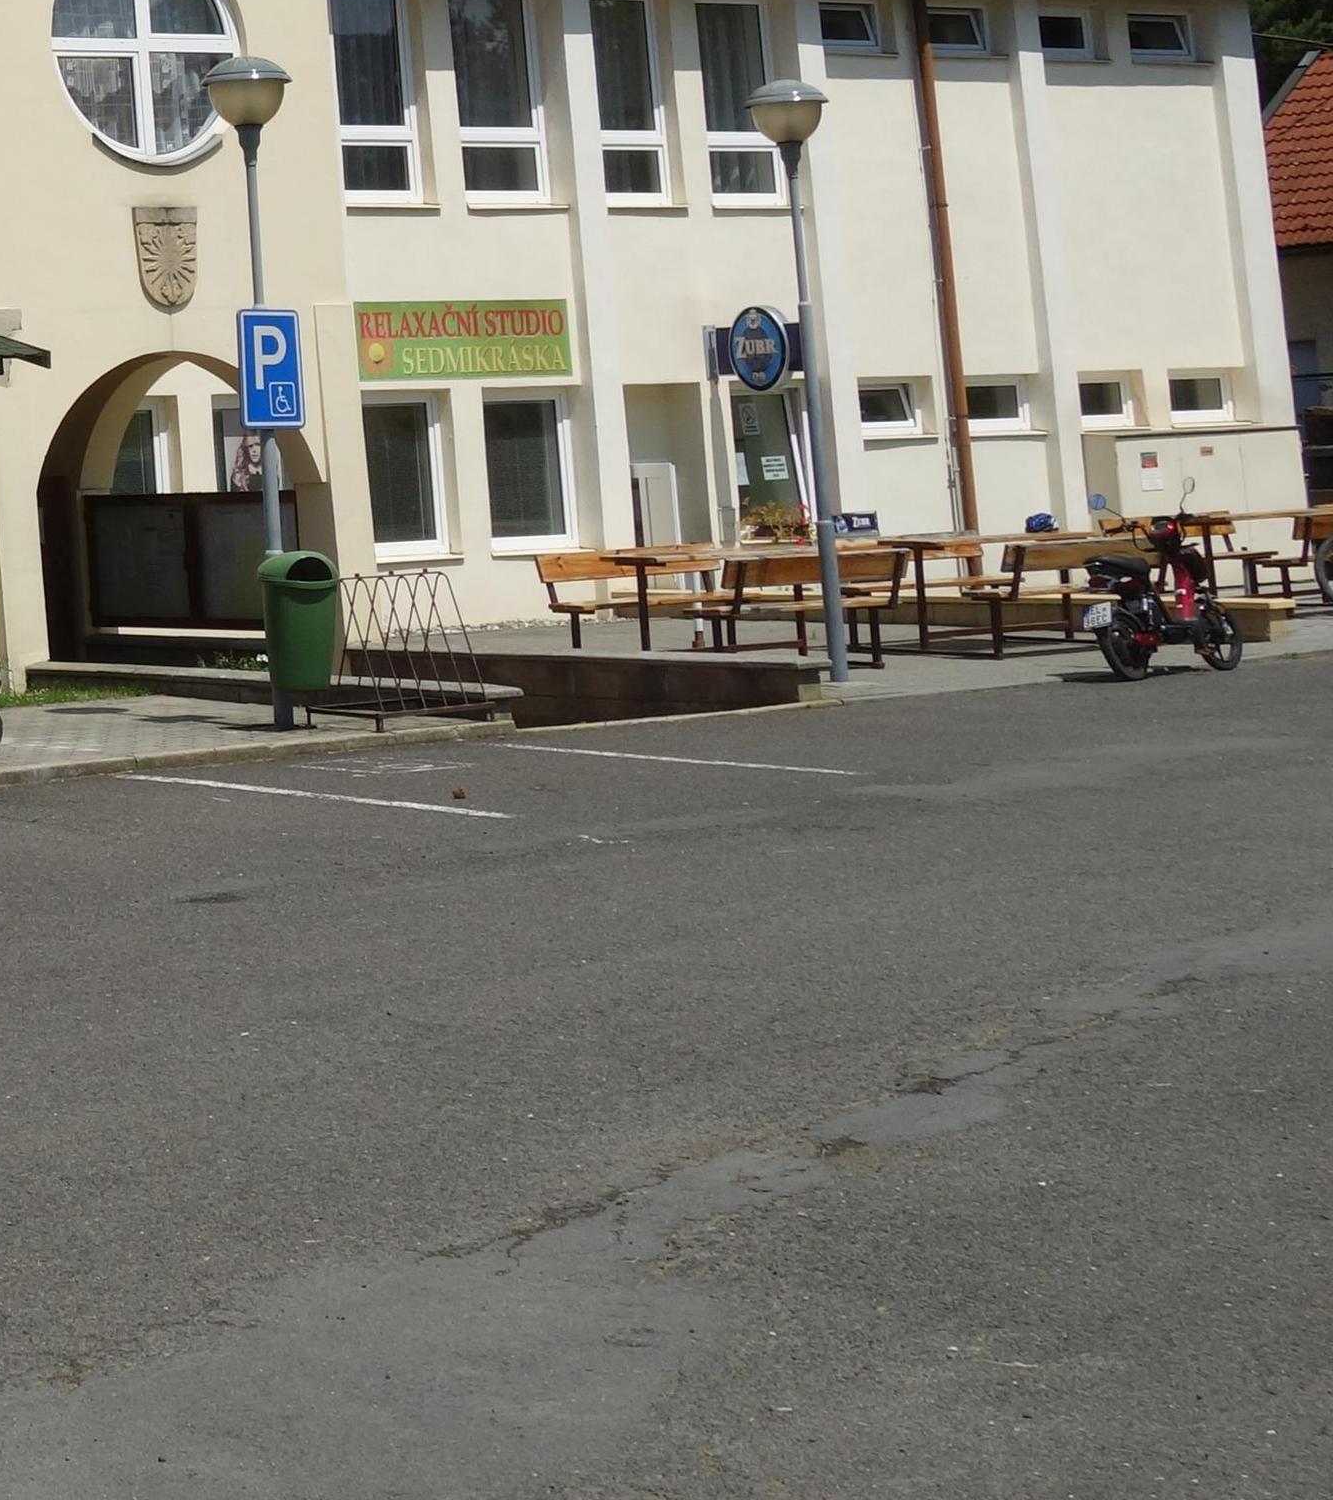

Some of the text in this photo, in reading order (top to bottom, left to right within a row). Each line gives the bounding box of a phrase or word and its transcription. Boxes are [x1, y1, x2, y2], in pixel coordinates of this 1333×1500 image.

[358, 303, 564, 339] RELAXAČNÍ STUDIO
[253, 325, 287, 390] P
[402, 339, 568, 375] SEDMIKRÁSKA
[734, 336, 778, 359] ZUBR
